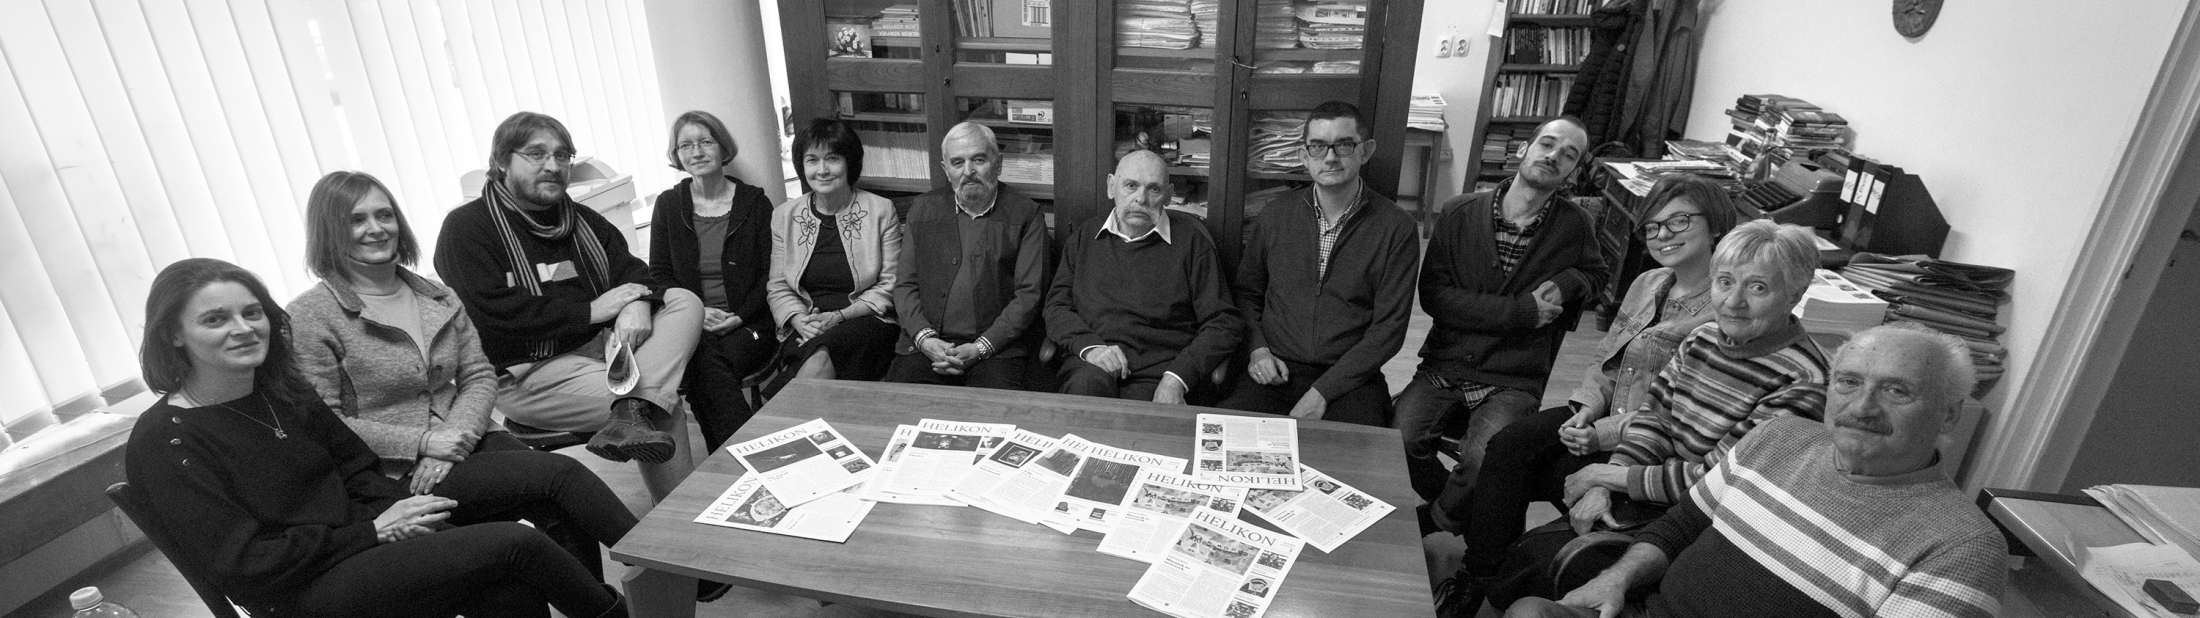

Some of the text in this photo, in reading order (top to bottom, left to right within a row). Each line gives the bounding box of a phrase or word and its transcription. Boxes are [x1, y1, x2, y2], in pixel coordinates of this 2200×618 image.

[922, 422, 993, 433] HELIKON
[735, 427, 808, 454] HELIKON
[1090, 447, 1164, 466] HELIKON
[1147, 473, 1223, 493] HELIKON
[1218, 474, 1296, 486] HELIKON
[705, 477, 758, 520] HELIKON
[1195, 511, 1277, 547] HELIKON
